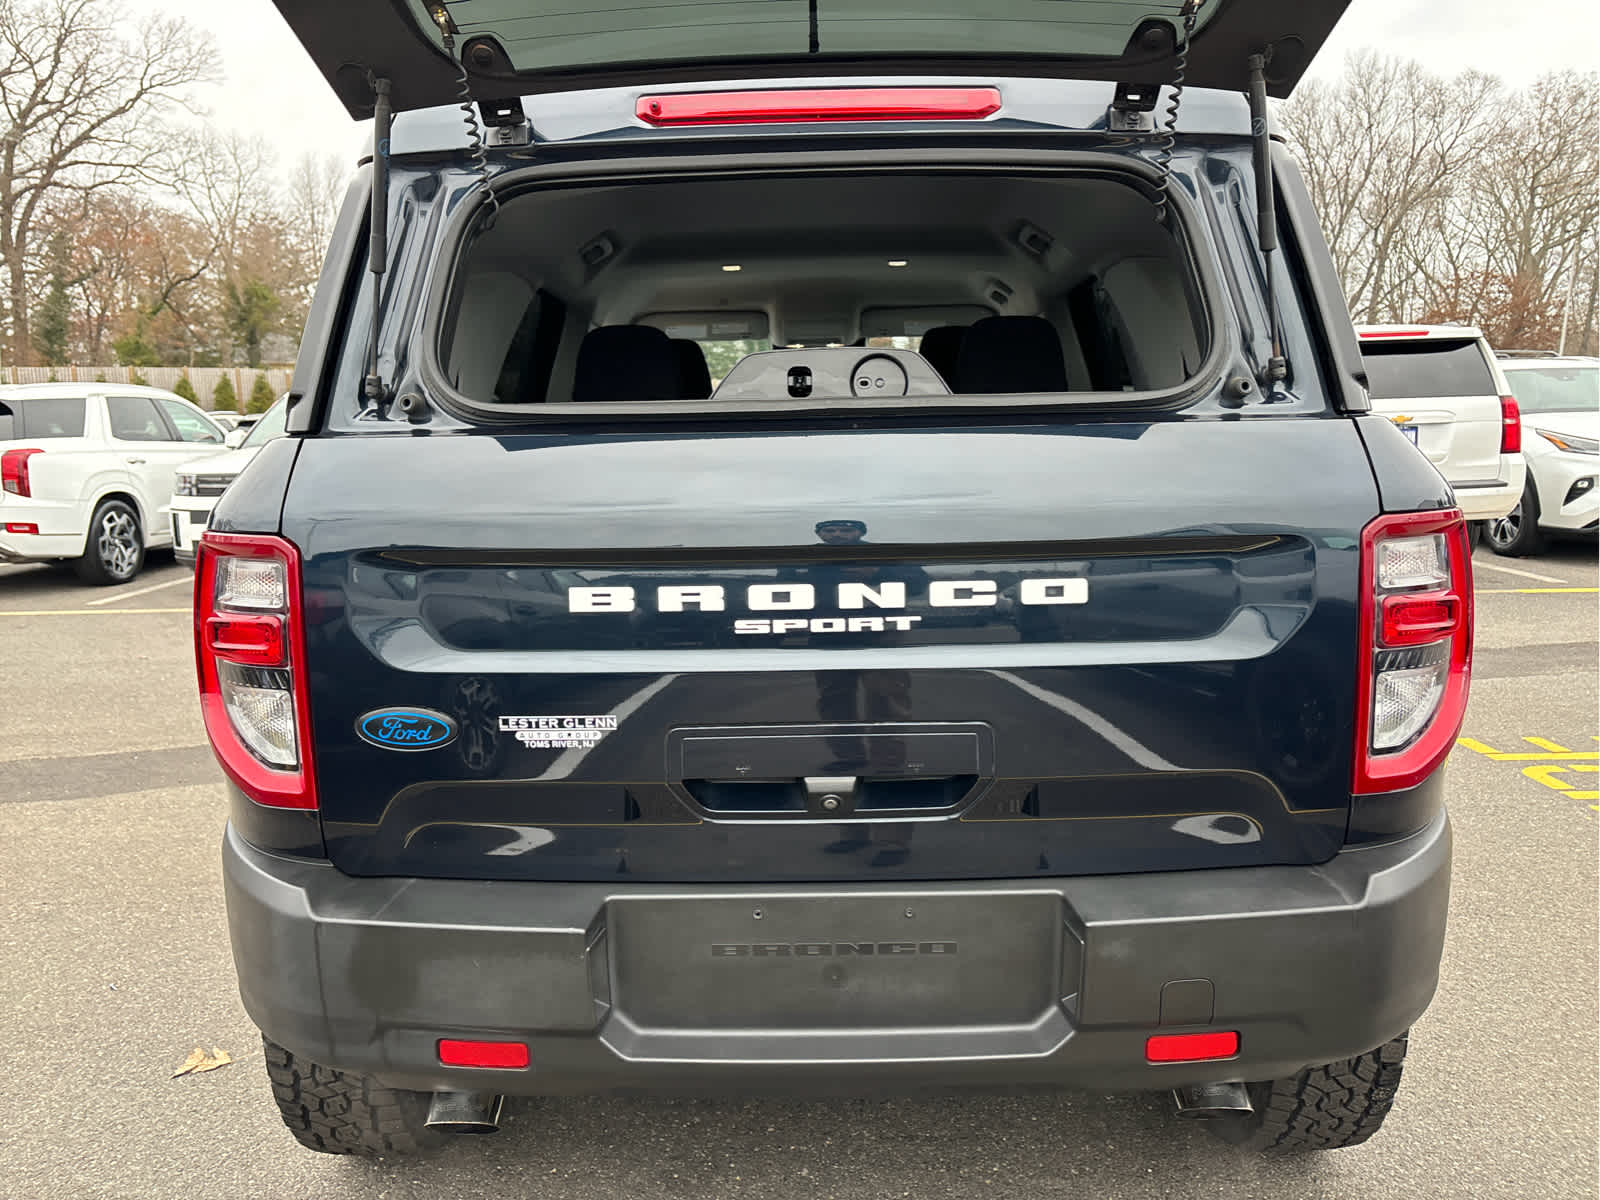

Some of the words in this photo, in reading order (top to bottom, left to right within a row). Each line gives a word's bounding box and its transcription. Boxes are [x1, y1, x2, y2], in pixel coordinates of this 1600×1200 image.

[568, 578, 1089, 613] BRONCO
[734, 616, 922, 634] SPORT
[378, 716, 432, 741] Ford
[499, 718, 558, 728] LESTER
[563, 717, 617, 728] GLENN
[524, 740, 550, 748] TOMS
[551, 740, 582, 749] RIVER,
[583, 740, 595, 748] NJ
[712, 941, 957, 956] BRONCO
